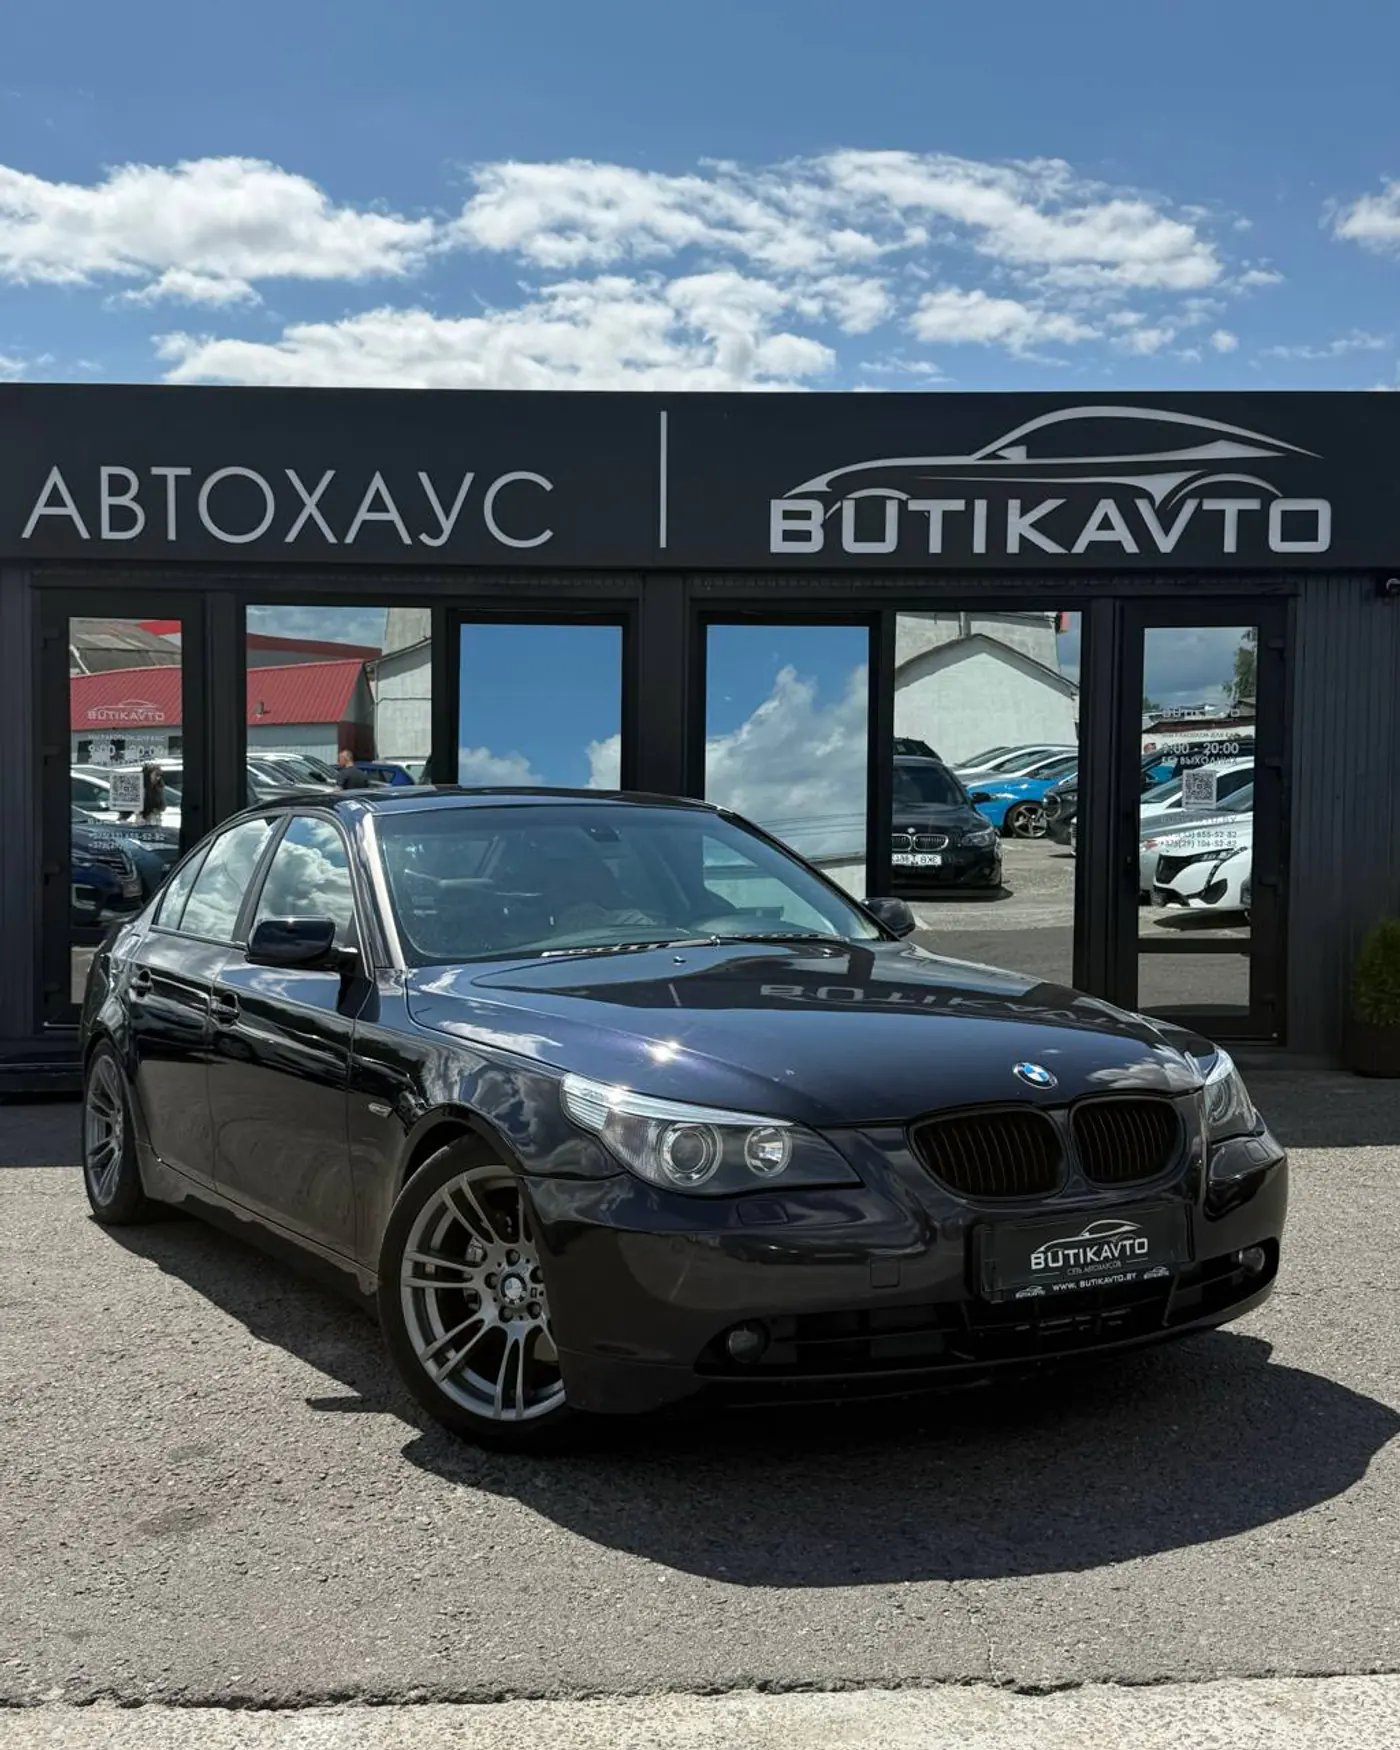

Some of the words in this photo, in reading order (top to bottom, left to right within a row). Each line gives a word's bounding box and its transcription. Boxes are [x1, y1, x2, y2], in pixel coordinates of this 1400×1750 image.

[21, 465, 555, 548] АВТОХАУС
[769, 498, 1332, 554] BUTIKAVTO
[87, 710, 165, 721] BUTIKAVTO
[1203, 742, 1239, 755] 20:00
[1030, 1238, 1149, 1270] BUTIKAVTO
